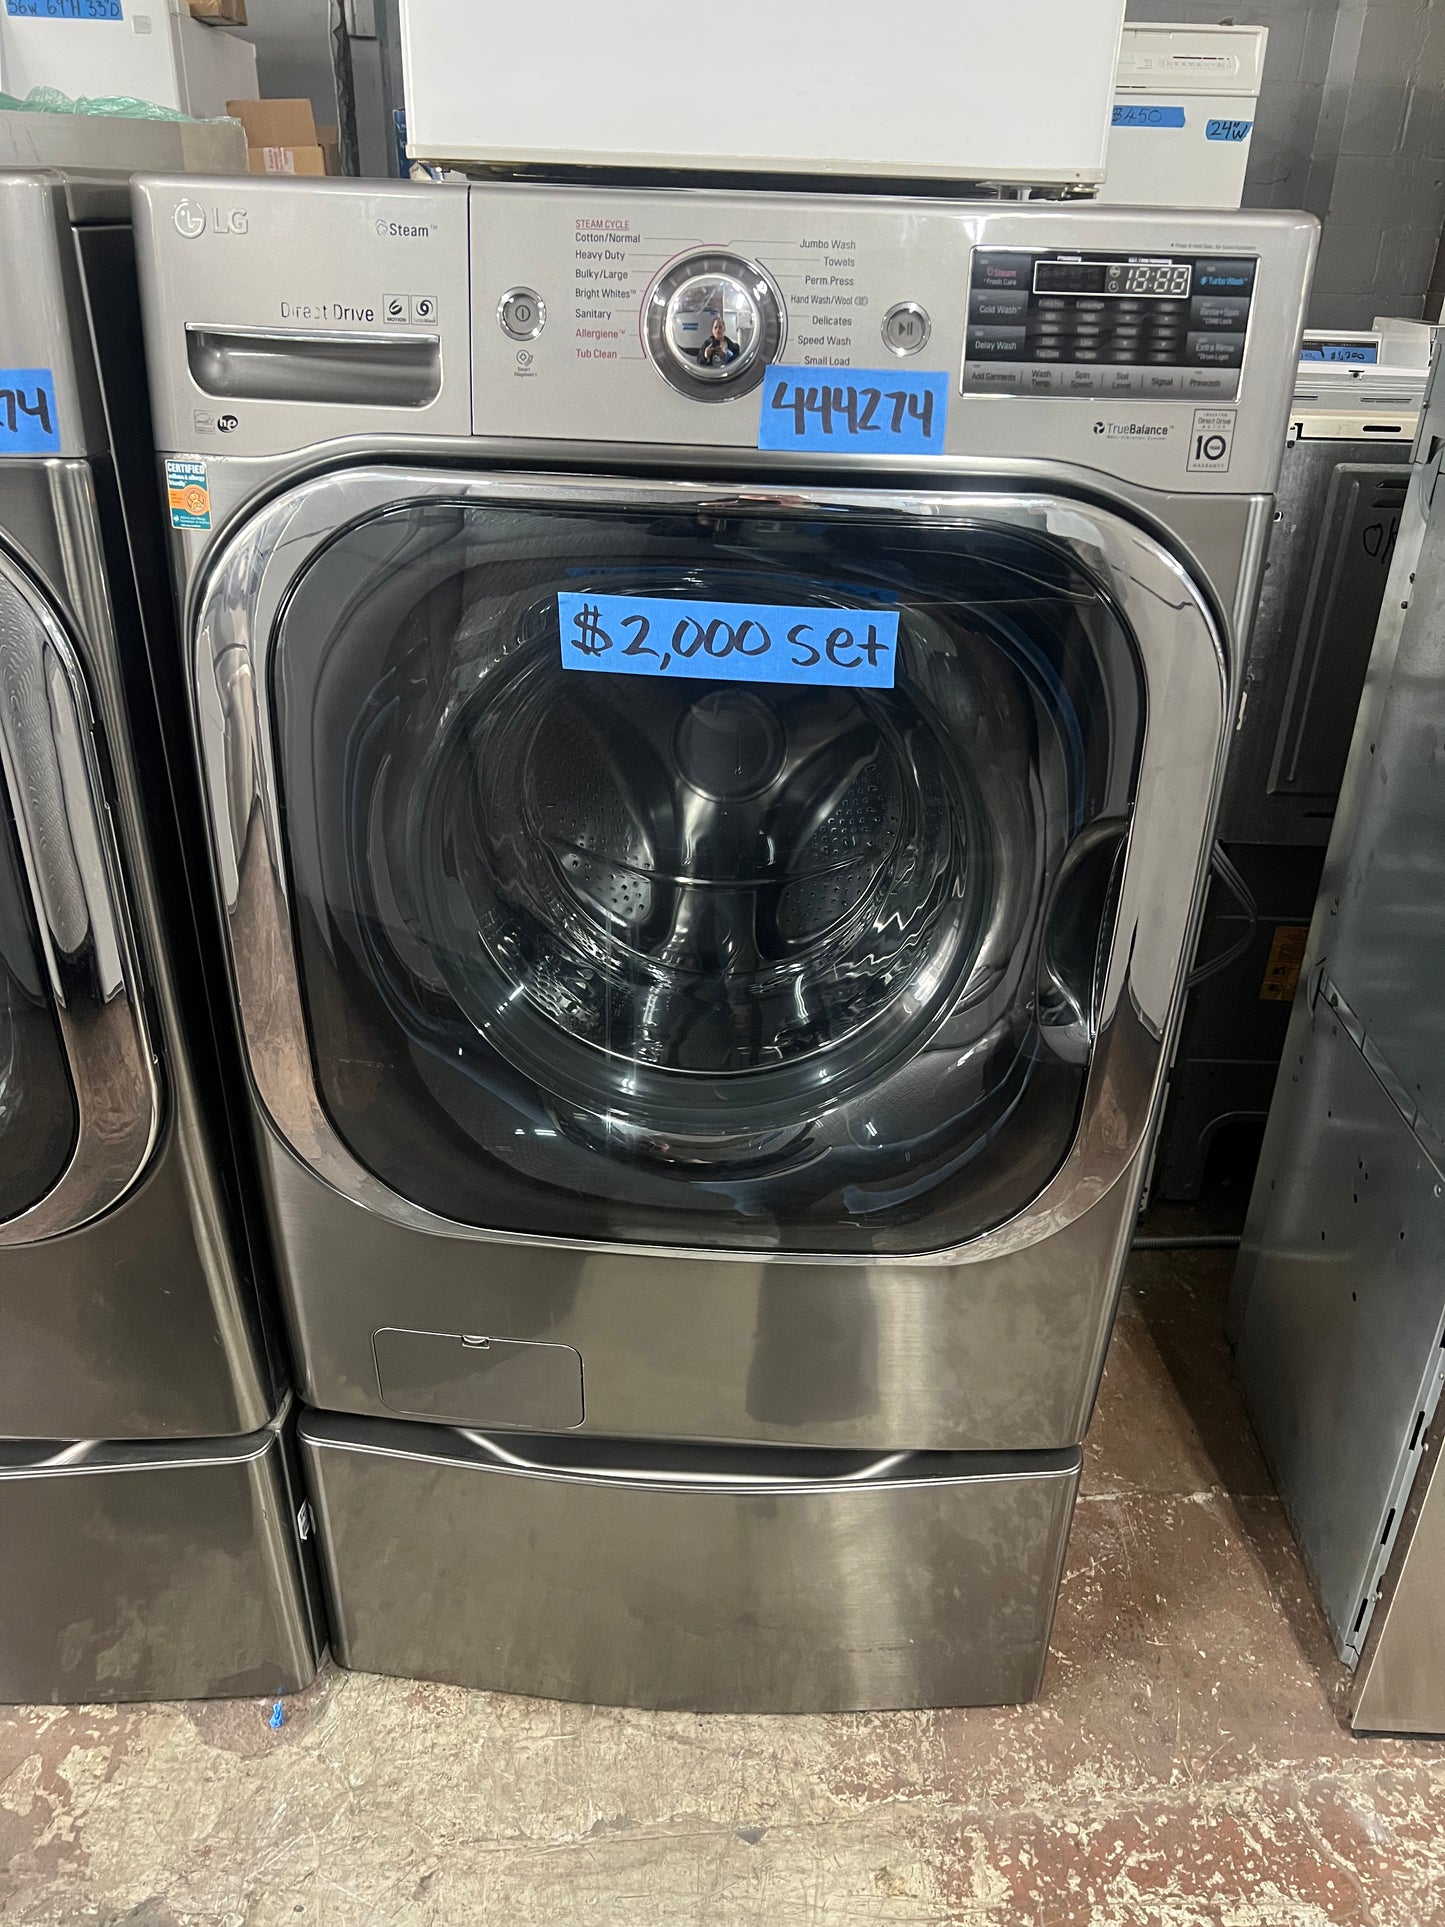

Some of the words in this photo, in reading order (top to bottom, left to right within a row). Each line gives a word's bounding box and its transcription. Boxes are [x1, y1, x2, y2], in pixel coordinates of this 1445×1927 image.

[212, 207, 249, 235] LG
[576, 219, 603, 229] STEAM
[604, 220, 629, 230] CYCLE
[575, 232, 640, 243] Cotton/Normal
[799, 238, 829, 249] Jumbo
[831, 239, 856, 250] Wash
[575, 249, 602, 261] Heavy
[604, 250, 625, 262] Duty
[824, 256, 855, 267] Towels
[575, 268, 628, 281] Bulky/Large
[830, 275, 854, 286] Press
[575, 288, 600, 300] Bright
[790, 294, 809, 304] Hand
[810, 295, 853, 305] Wash/Wool
[333, 304, 374, 322] Drive
[575, 308, 611, 320] Sanitary
[980, 304, 995, 314] Cold
[812, 315, 852, 326] Delicates
[797, 334, 825, 346] Speed
[826, 336, 851, 346] Wash
[975, 340, 995, 351] Delay
[996, 341, 1017, 350] Wash
[576, 348, 592, 359] Tub
[594, 348, 617, 359] Clean
[804, 355, 828, 366] Small
[829, 356, 850, 367] Load
[972, 372, 984, 380] Add
[1151, 378, 1174, 387] Signal
[771, 381, 934, 439] 444274
[1196, 435, 1226, 460] 10
[167, 462, 205, 475] CERTIFIED
[570, 602, 772, 671] $2,000
